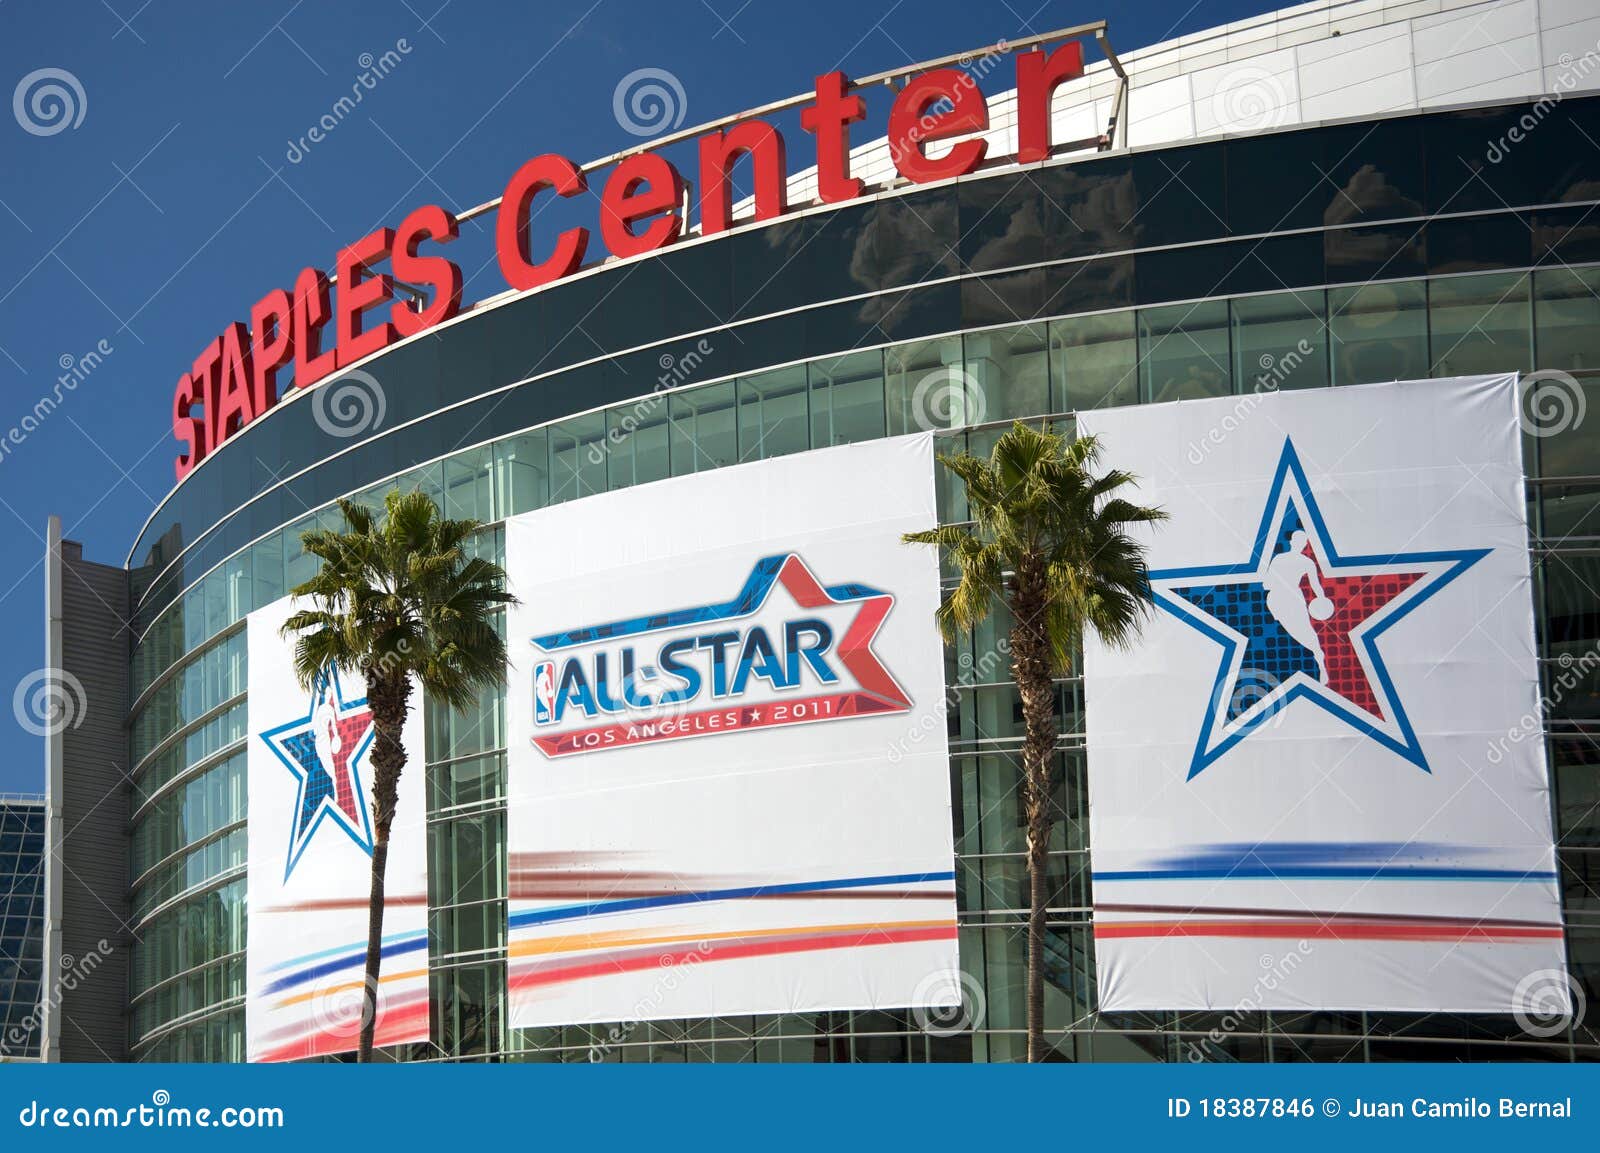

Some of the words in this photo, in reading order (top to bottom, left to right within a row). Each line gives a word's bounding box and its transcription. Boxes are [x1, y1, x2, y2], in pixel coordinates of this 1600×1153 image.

[172, 204, 463, 482] STAPLES
[496, 40, 1084, 292] Center
[554, 618, 838, 718] ALL-STAR
[572, 730, 615, 748] LOS
[626, 712, 738, 741] ANGELES
[773, 700, 832, 720] 2011
